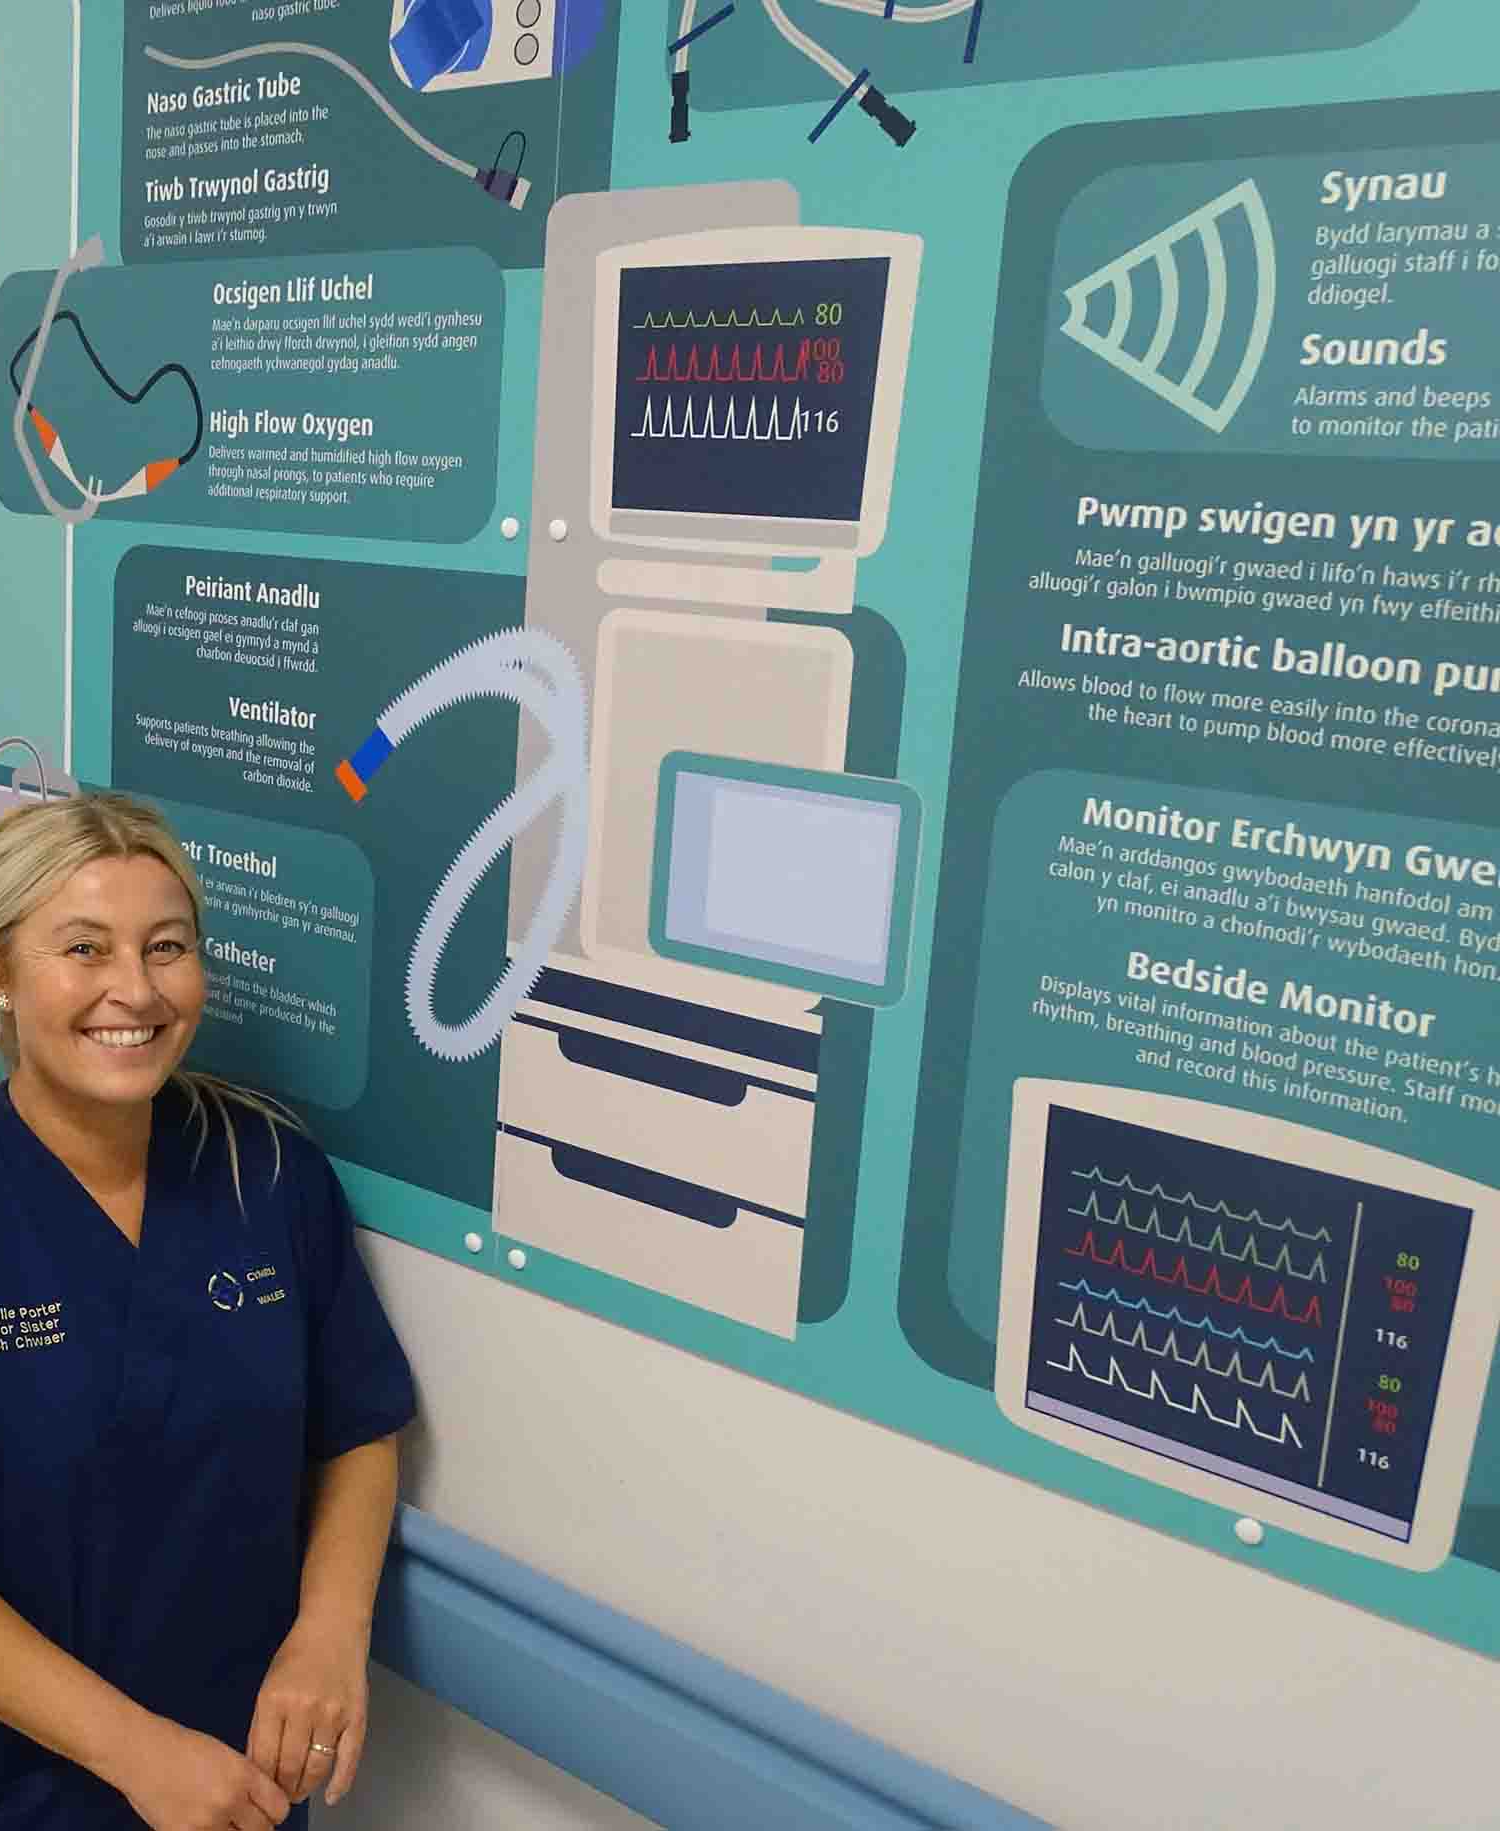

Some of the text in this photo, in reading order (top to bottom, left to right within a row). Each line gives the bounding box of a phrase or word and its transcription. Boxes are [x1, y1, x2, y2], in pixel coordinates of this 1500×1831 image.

[147, 71, 301, 114] Naso Gastric Tube
[145, 104, 329, 140] The naso gastric tube is placed into the
[144, 162, 329, 203] Tiwb Trwynol Gastrig
[1319, 170, 1447, 212] Synau
[1314, 221, 1489, 250] Bydd larymau a
[1309, 251, 1397, 281] galluogi
[1403, 248, 1456, 272] staff
[1461, 249, 1468, 270] i
[212, 273, 373, 308] Ocsigen Llif Uchel
[1307, 282, 1393, 310] ddiogel.
[815, 302, 843, 326] 80
[1299, 327, 1447, 365] Sounds
[1293, 384, 1491, 411] Alarms and beeps
[209, 408, 373, 442] High Flow Oxygen
[801, 410, 840, 433] 116
[1291, 415, 1312, 435] to
[1317, 417, 1404, 436] monitor
[1411, 415, 1448, 438] the
[208, 443, 462, 469] Delivers warmed and humidified high flow oxygen
[1076, 496, 1187, 538] Pwmp
[1197, 502, 1336, 544] swigen
[1350, 514, 1398, 549] yn
[1413, 517, 1455, 552] yr
[185, 575, 320, 609] Peiriant Anadlu
[1060, 622, 1260, 669] Intra-aortic
[1271, 639, 1421, 685] balloon
[228, 696, 317, 730] Ventilator
[1017, 669, 1076, 692] Allows
[1081, 675, 1133, 698] blood
[1138, 681, 1157, 701] to
[1163, 683, 1206, 705] flow
[1210, 692, 1263, 712] more
[1269, 697, 1329, 723] easily
[1334, 701, 1376, 724] into
[1383, 705, 1419, 729] the
[135, 712, 315, 755] Supports patients breathing allowing the
[1087, 702, 1118, 723] the
[1123, 705, 1172, 729] heart
[1178, 713, 1197, 732] to
[1203, 718, 1261, 744] pump
[1266, 721, 1324, 747] blood
[1329, 733, 1387, 754] more
[1082, 797, 1220, 843] Monitor
[1231, 818, 1391, 872] Erchwyn
[207, 843, 277, 879] Troethol
[1126, 951, 1436, 1037] Bedside Monitor
[1039, 974, 1479, 1082] Displays vital information about the patient's
[1134, 1048, 1408, 1123] and record this information.
[246, 1266, 276, 1282] CYMRU
[1396, 1252, 1420, 1271] 80
[18, 1301, 62, 1319] Porter
[257, 1288, 286, 1305] WALES
[14, 1331, 65, 1349] Chwaer
[19, 1317, 59, 1333] Sister
[1375, 1327, 1408, 1350] 116
[1379, 1375, 1402, 1393] 80
[1357, 1447, 1390, 1471] 116
